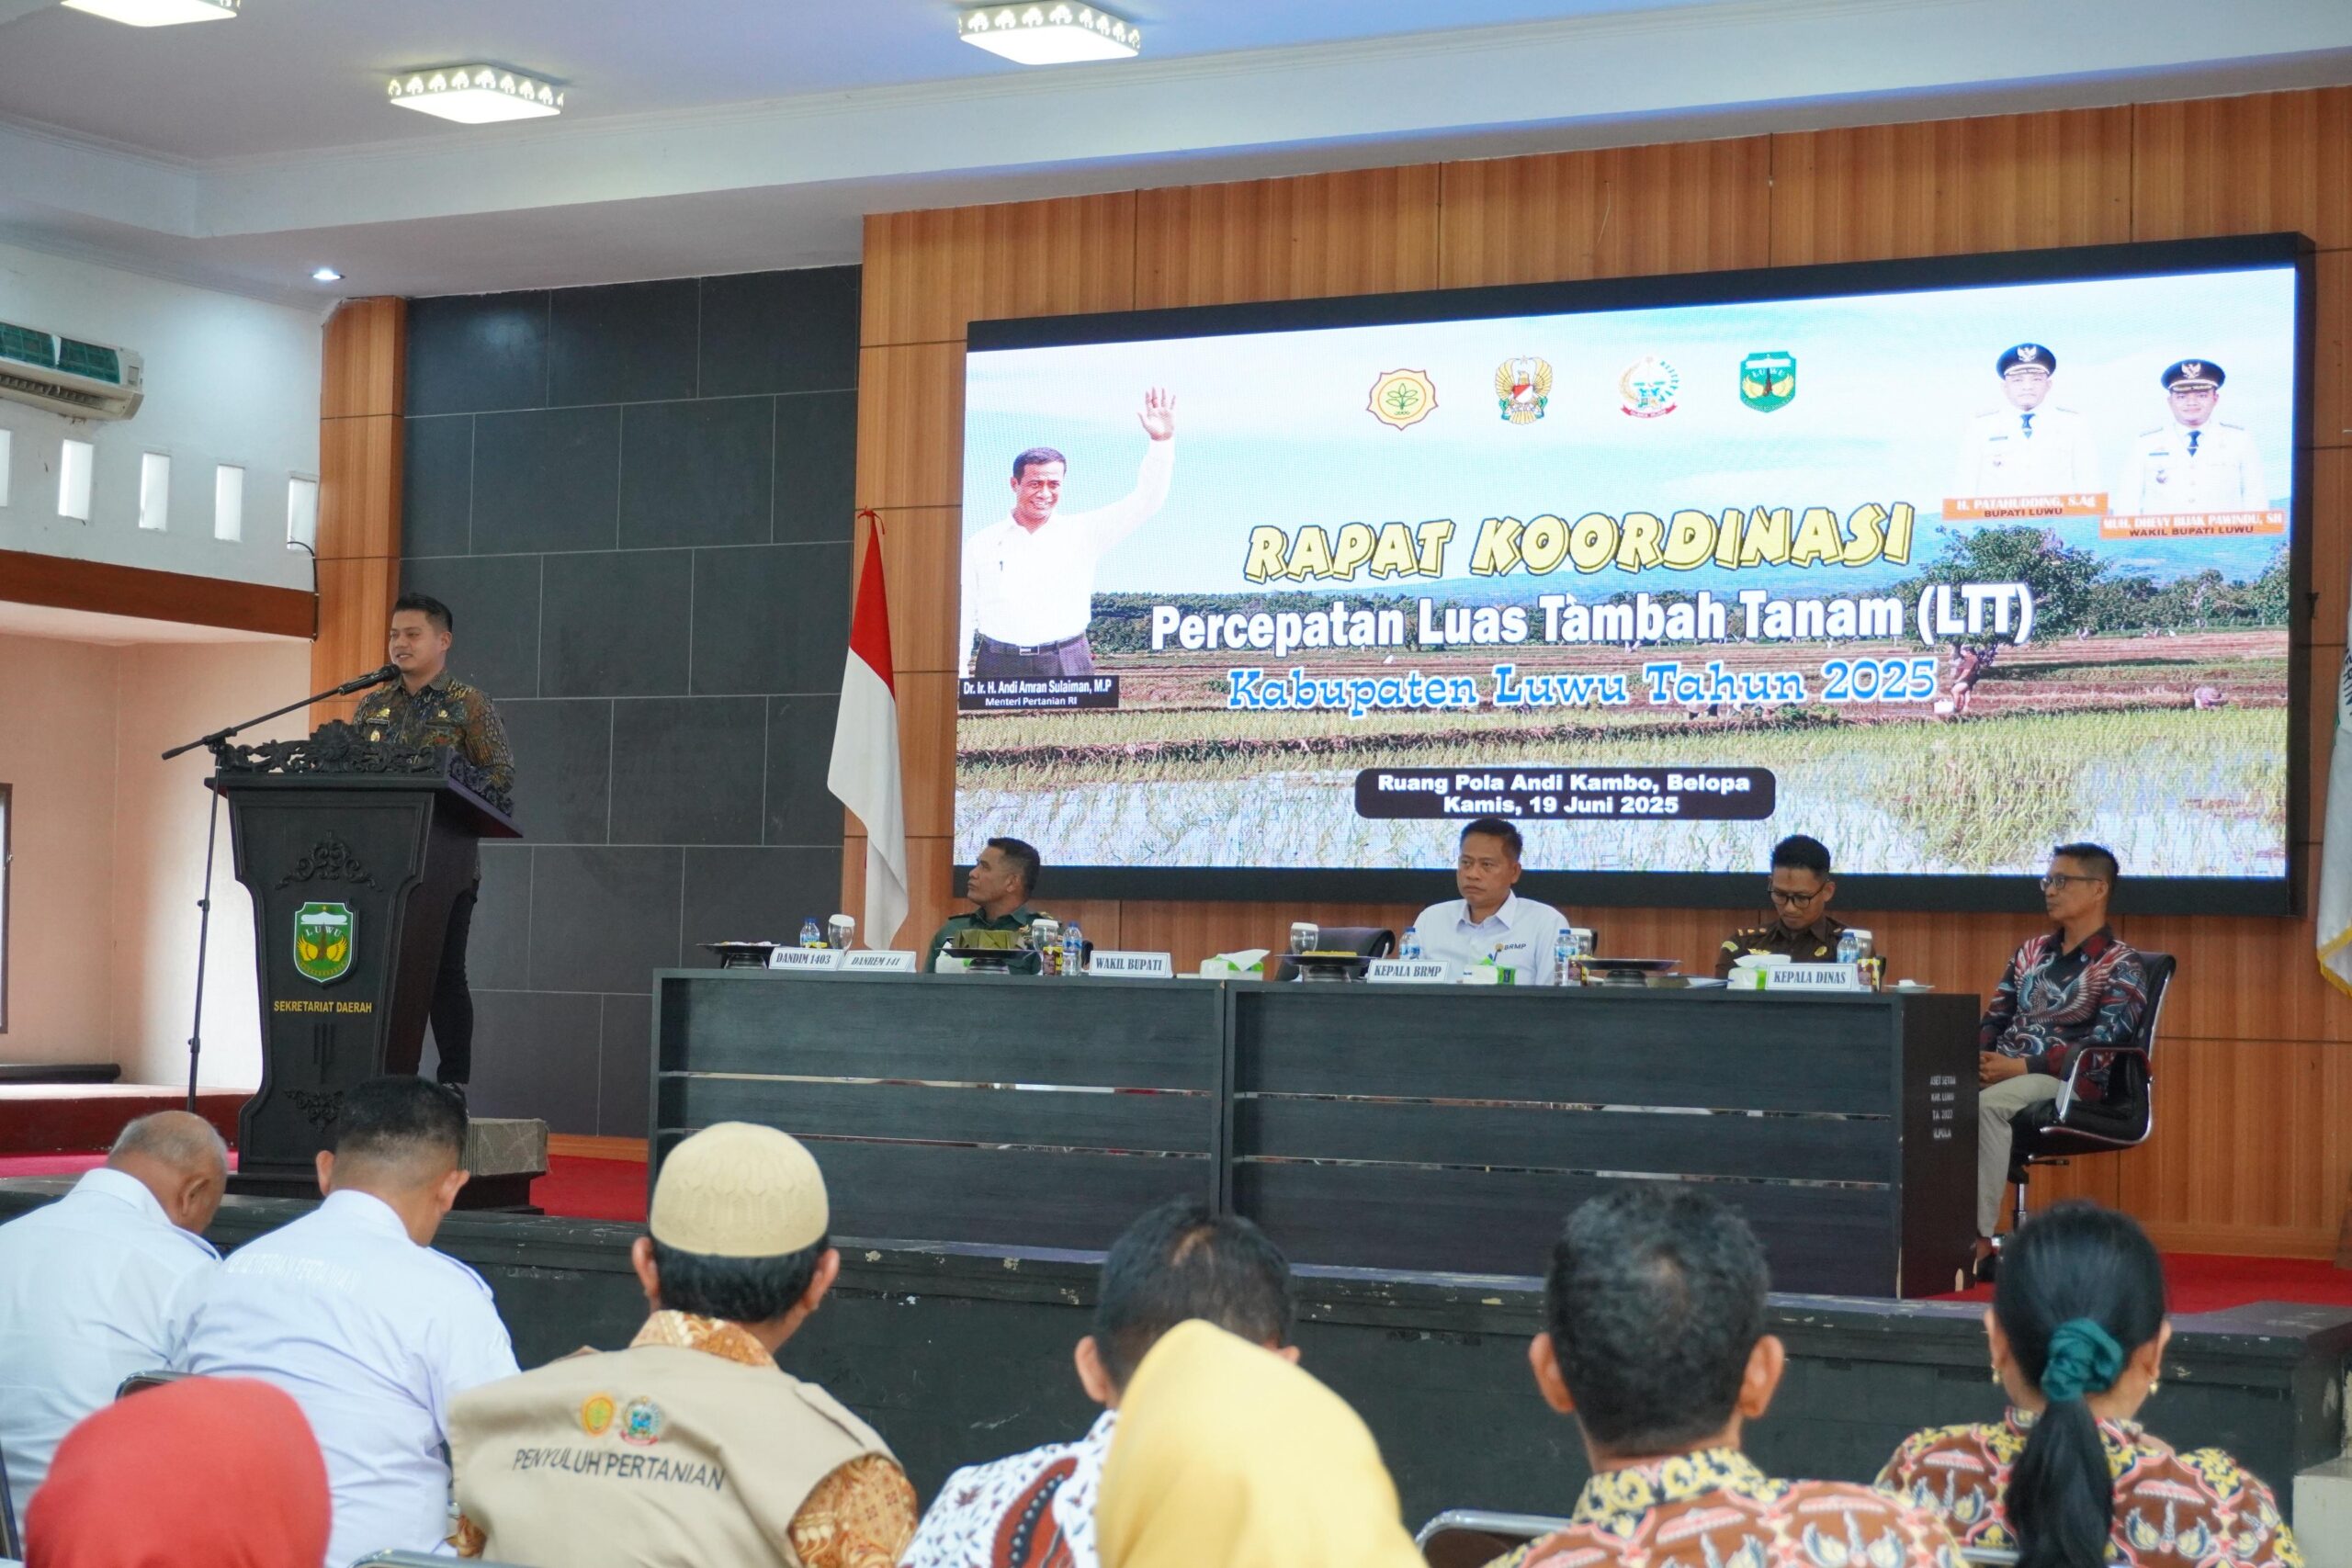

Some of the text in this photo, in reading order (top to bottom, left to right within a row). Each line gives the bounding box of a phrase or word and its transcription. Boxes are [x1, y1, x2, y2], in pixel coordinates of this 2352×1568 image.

[1957, 500, 1969, 510] H.
[1984, 508, 2063, 517] BUPATI LUWU
[2267, 513, 2283, 524] SH
[2130, 525, 2254, 536] WAKIL BUPATI LUWU
[1245, 502, 1915, 584] RAPAT KOORDINASI
[1151, 581, 2035, 658] Percepatan Luas Tambah Tanam (LTT)
[964, 679, 1112, 694] Dr. Ir. H. Andi Amran Sulaiman, M.P
[1227, 655, 1939, 720] Kabupaten Luwu Tahun 2025
[985, 696, 1077, 705] Menteri Pertanian RI
[1378, 773, 1750, 795] Ruang Pola Andi Kambo, Belopa
[1443, 795, 1679, 817] Kamis, 19 Juni 2025
[306, 926, 342, 937] LUWU
[776, 953, 831, 964] DANDIM 1403
[851, 956, 884, 966] DANREM
[1095, 957, 1162, 972] WAKIL BUPATI
[1374, 964, 1442, 977] KEPALA BRMP
[1774, 970, 1847, 985] KEPALA DINAS
[274, 1000, 372, 1013] SEKRETARIAT DAERAH
[513, 1448, 726, 1492] PENYULUH PERTANIAN
